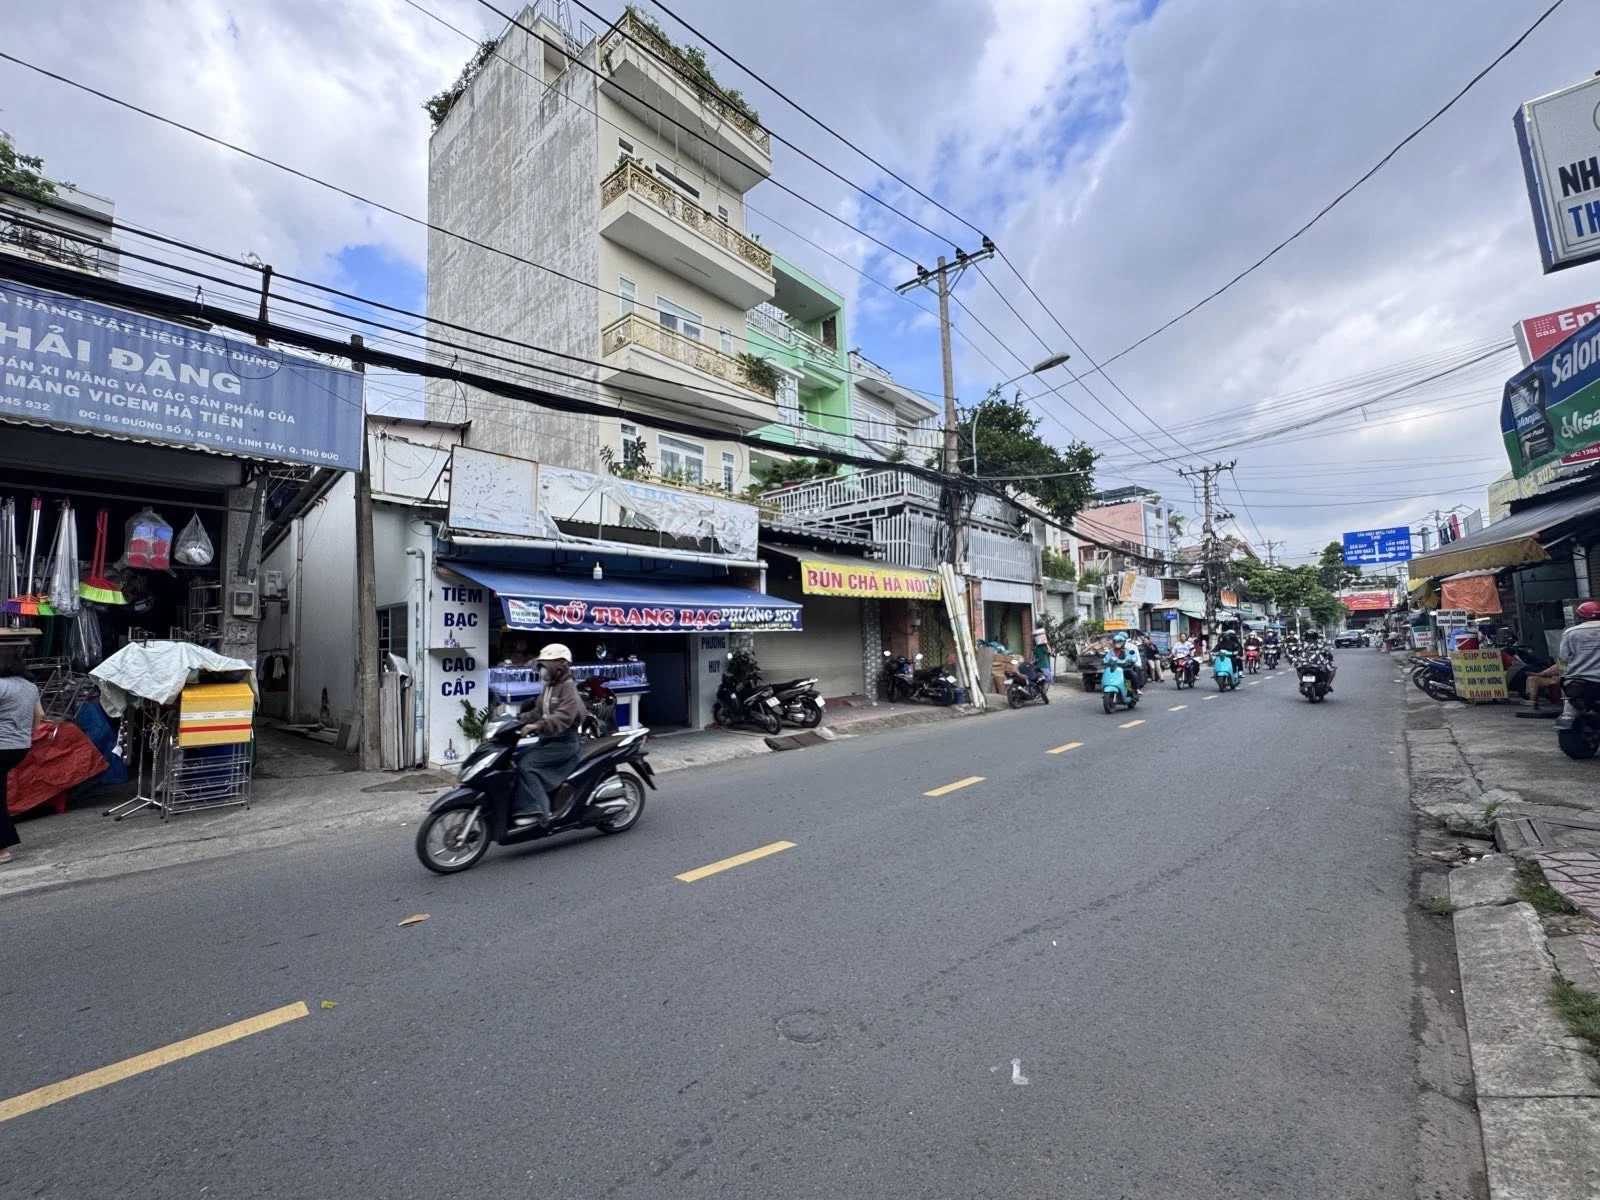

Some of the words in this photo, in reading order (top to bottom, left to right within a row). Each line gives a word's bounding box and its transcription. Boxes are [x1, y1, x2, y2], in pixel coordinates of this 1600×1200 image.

[92, 314, 134, 334] VẬT
[0, 323, 91, 362] HẢI
[109, 347, 241, 395] ĐĂNG
[5, 372, 80, 398] MĂNG
[88, 388, 158, 413] VICEM
[165, 403, 193, 419] HÀ
[199, 410, 244, 429] TIÊN
[41, 363, 59, 377] XI
[65, 369, 119, 389] MĂNG
[125, 381, 147, 395] VÀ
[152, 387, 185, 402] CÁC
[189, 394, 220, 409] SẢN
[224, 401, 265, 418] PHẨM
[267, 409, 295, 424] CỦA
[25, 399, 51, 411] 932
[78, 409, 100, 420] ĐC:
[103, 413, 119, 423] 95
[121, 416, 163, 430] ĐƯỜNG
[166, 423, 181, 434] SỐ
[197, 430, 212, 439] KP
[238, 437, 262, 448] LINH
[264, 442, 286, 453] TÂY,
[300, 448, 319, 458] THỦ
[321, 451, 339, 461] ĐỨC
[807, 567, 843, 589] BÚN
[848, 571, 879, 591] CHẢ
[882, 574, 902, 592] HÀ
[441, 584, 482, 606] TIỆM
[443, 612, 478, 631] BẠC
[543, 600, 588, 625] NỮ
[590, 606, 676, 627] TRANG
[679, 608, 721, 630] BẠC
[720, 606, 774, 622] PHƯƠNG
[774, 608, 800, 622] HUY
[442, 657, 476, 673] CAO
[708, 660, 721, 673] HUY
[441, 675, 476, 697] CẤP
